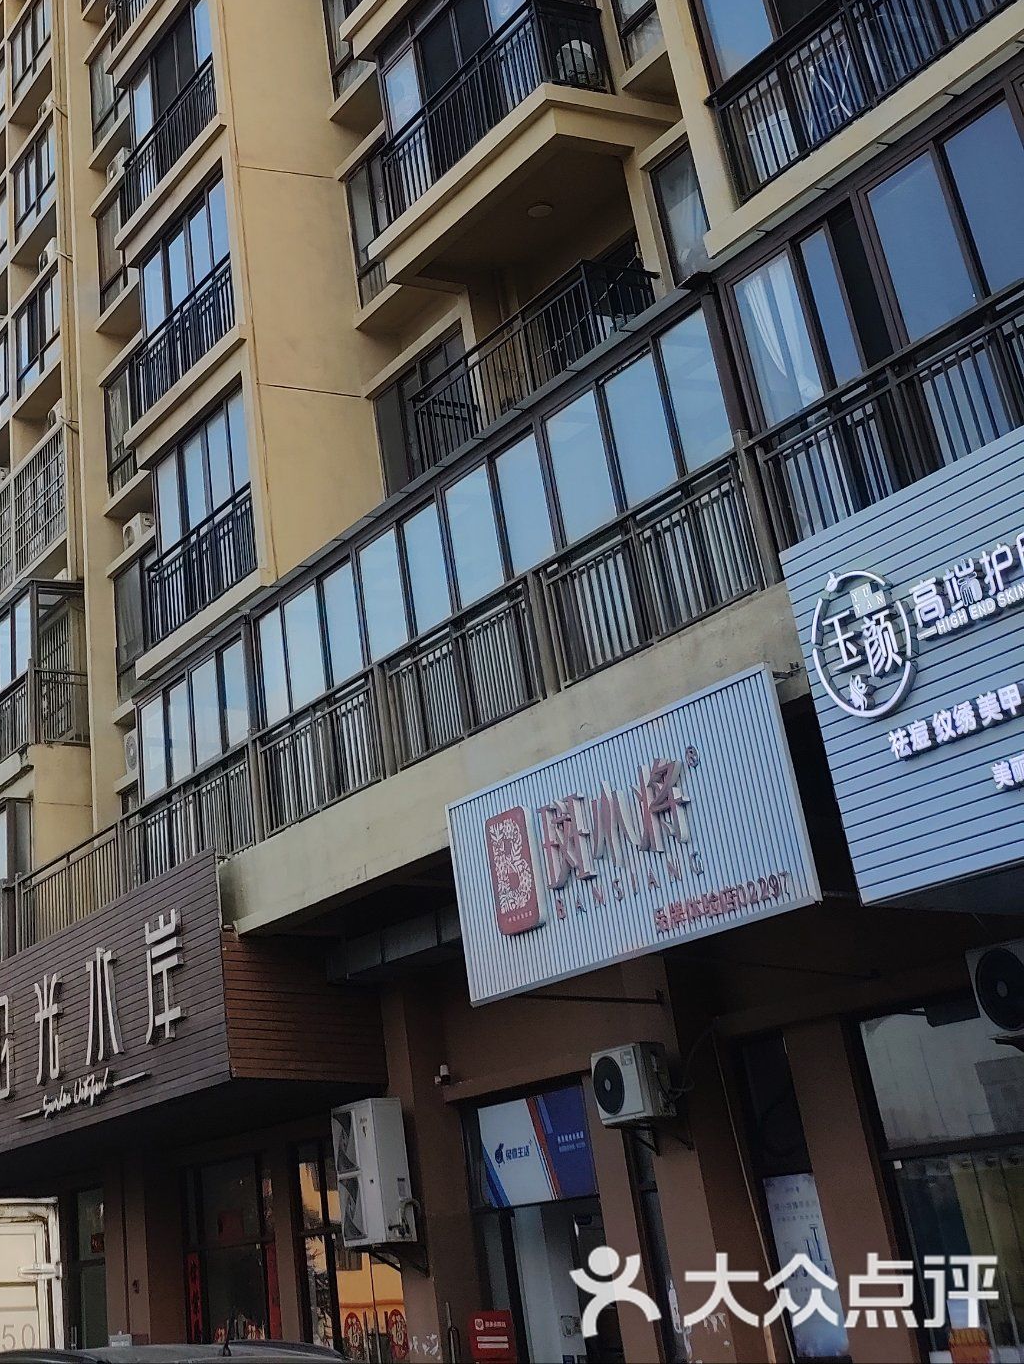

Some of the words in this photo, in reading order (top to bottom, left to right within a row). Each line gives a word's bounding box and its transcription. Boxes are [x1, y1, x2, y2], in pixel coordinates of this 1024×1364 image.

[822, 608, 904, 678] 玉颜
[936, 610, 968, 636] HIGH
[968, 597, 996, 621] END
[888, 719, 933, 761] 祛痘
[932, 699, 977, 744] 纹绣
[976, 683, 1022, 727] 美甲
[553, 850, 705, 921] BANSIANG
